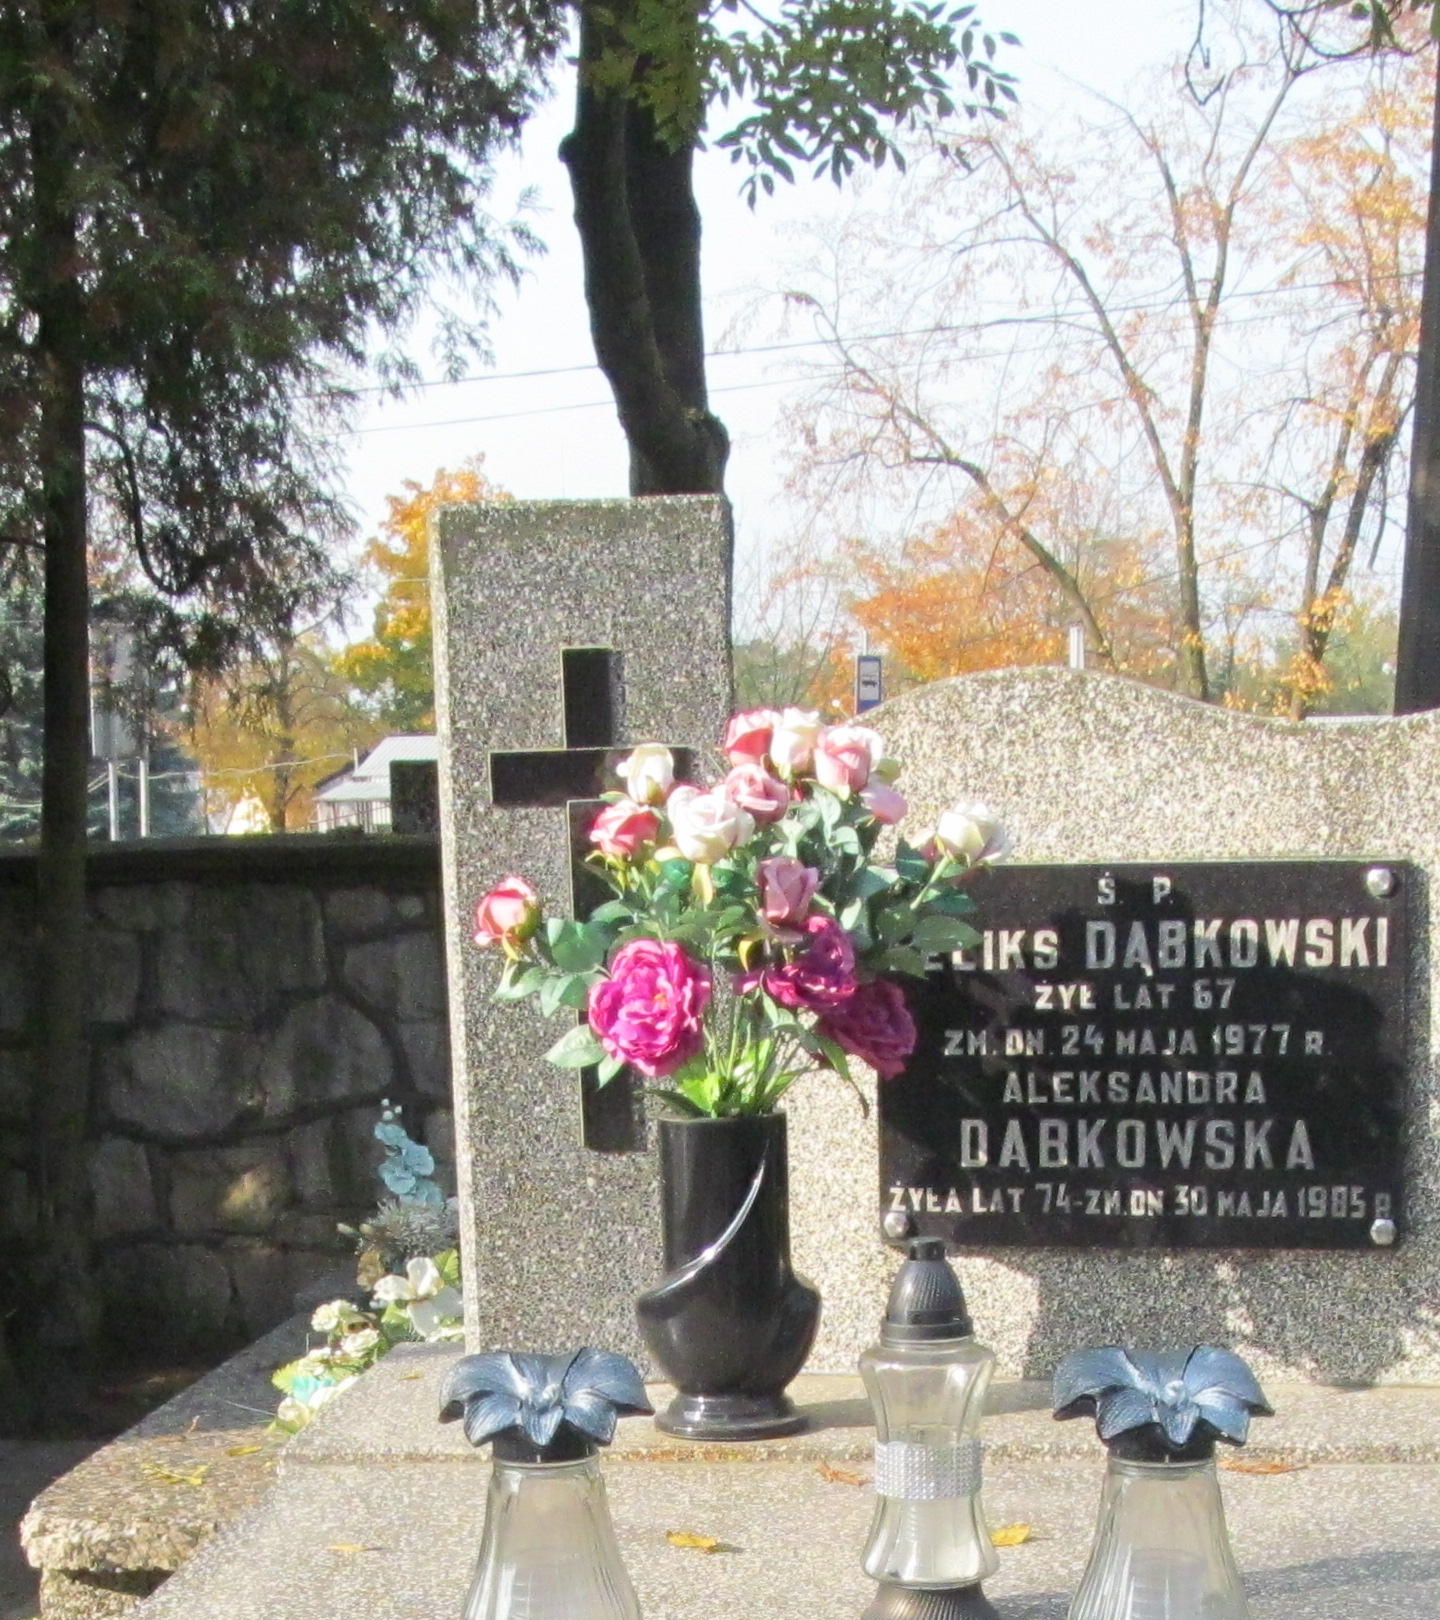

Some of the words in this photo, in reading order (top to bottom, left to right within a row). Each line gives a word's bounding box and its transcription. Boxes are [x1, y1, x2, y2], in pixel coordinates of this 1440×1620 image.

[922, 929, 1058, 971] ELIKS
[1085, 917, 1388, 976] DĄBKOWSKI
[1035, 980, 1095, 1010] ŻYŁ
[1115, 983, 1174, 1009] LAT
[1193, 980, 1235, 1009] 67
[944, 1029, 997, 1056] ZM.
[1061, 1024, 1104, 1055] 24
[1116, 1027, 1198, 1056] MAJA
[1212, 1023, 1291, 1055] 1977
[1003, 1071, 1267, 1104] ALEKSANDRA
[960, 1118, 1316, 1173] DĄBKOWSKA
[889, 1181, 962, 1213] ŻYŁA
[972, 1187, 1025, 1213] LAT
[1174, 1184, 1209, 1216] 30
[1218, 1190, 1289, 1217] MAJA
[1298, 1185, 1367, 1218] 1985
